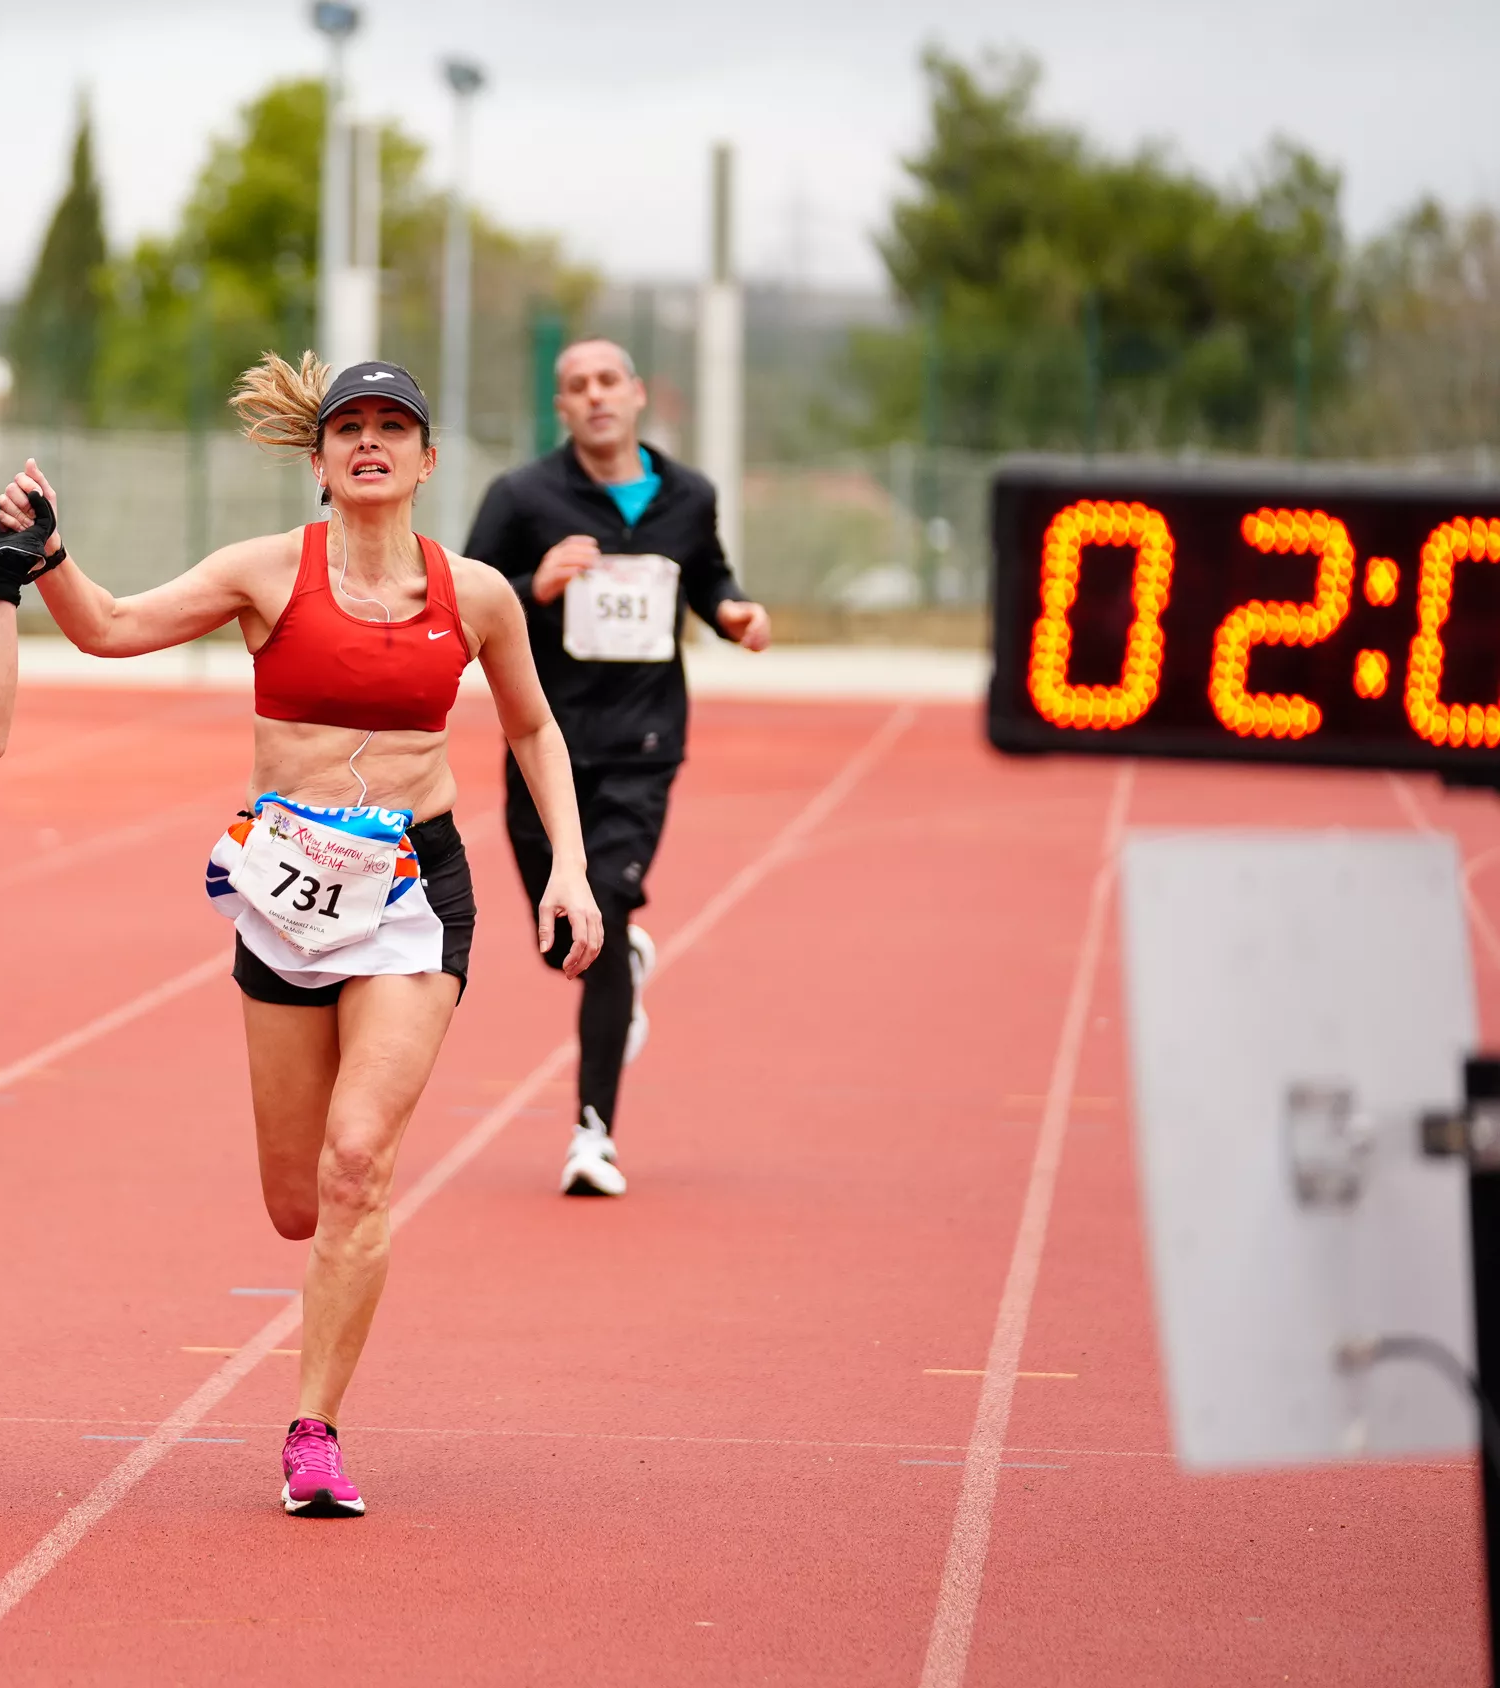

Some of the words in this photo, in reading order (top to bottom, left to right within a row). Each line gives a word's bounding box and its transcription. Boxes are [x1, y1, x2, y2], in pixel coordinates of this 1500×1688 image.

[596, 593, 649, 621] 581
[306, 845, 349, 871] LUCENA
[270, 860, 343, 919] 731
